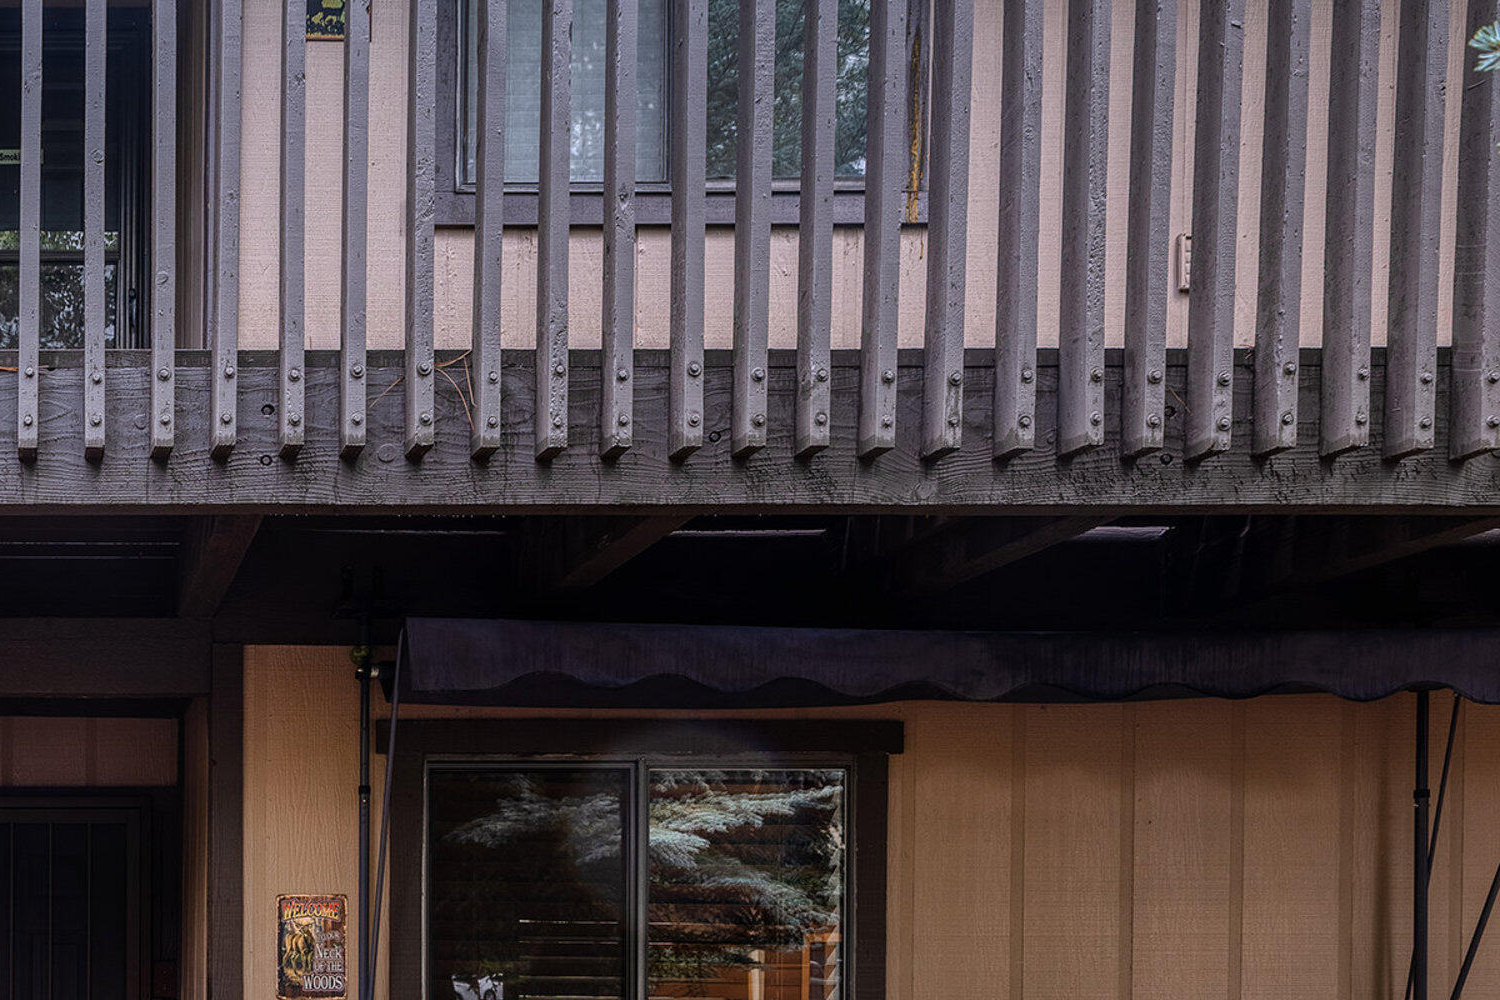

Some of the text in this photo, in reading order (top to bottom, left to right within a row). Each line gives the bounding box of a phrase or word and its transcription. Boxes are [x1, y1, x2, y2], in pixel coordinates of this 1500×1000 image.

[0, 153, 21, 161] Smoki
[283, 901, 340, 920] WELCOME
[315, 943, 342, 959] NECK
[326, 960, 342, 971] THE
[303, 974, 344, 990] WOODS
